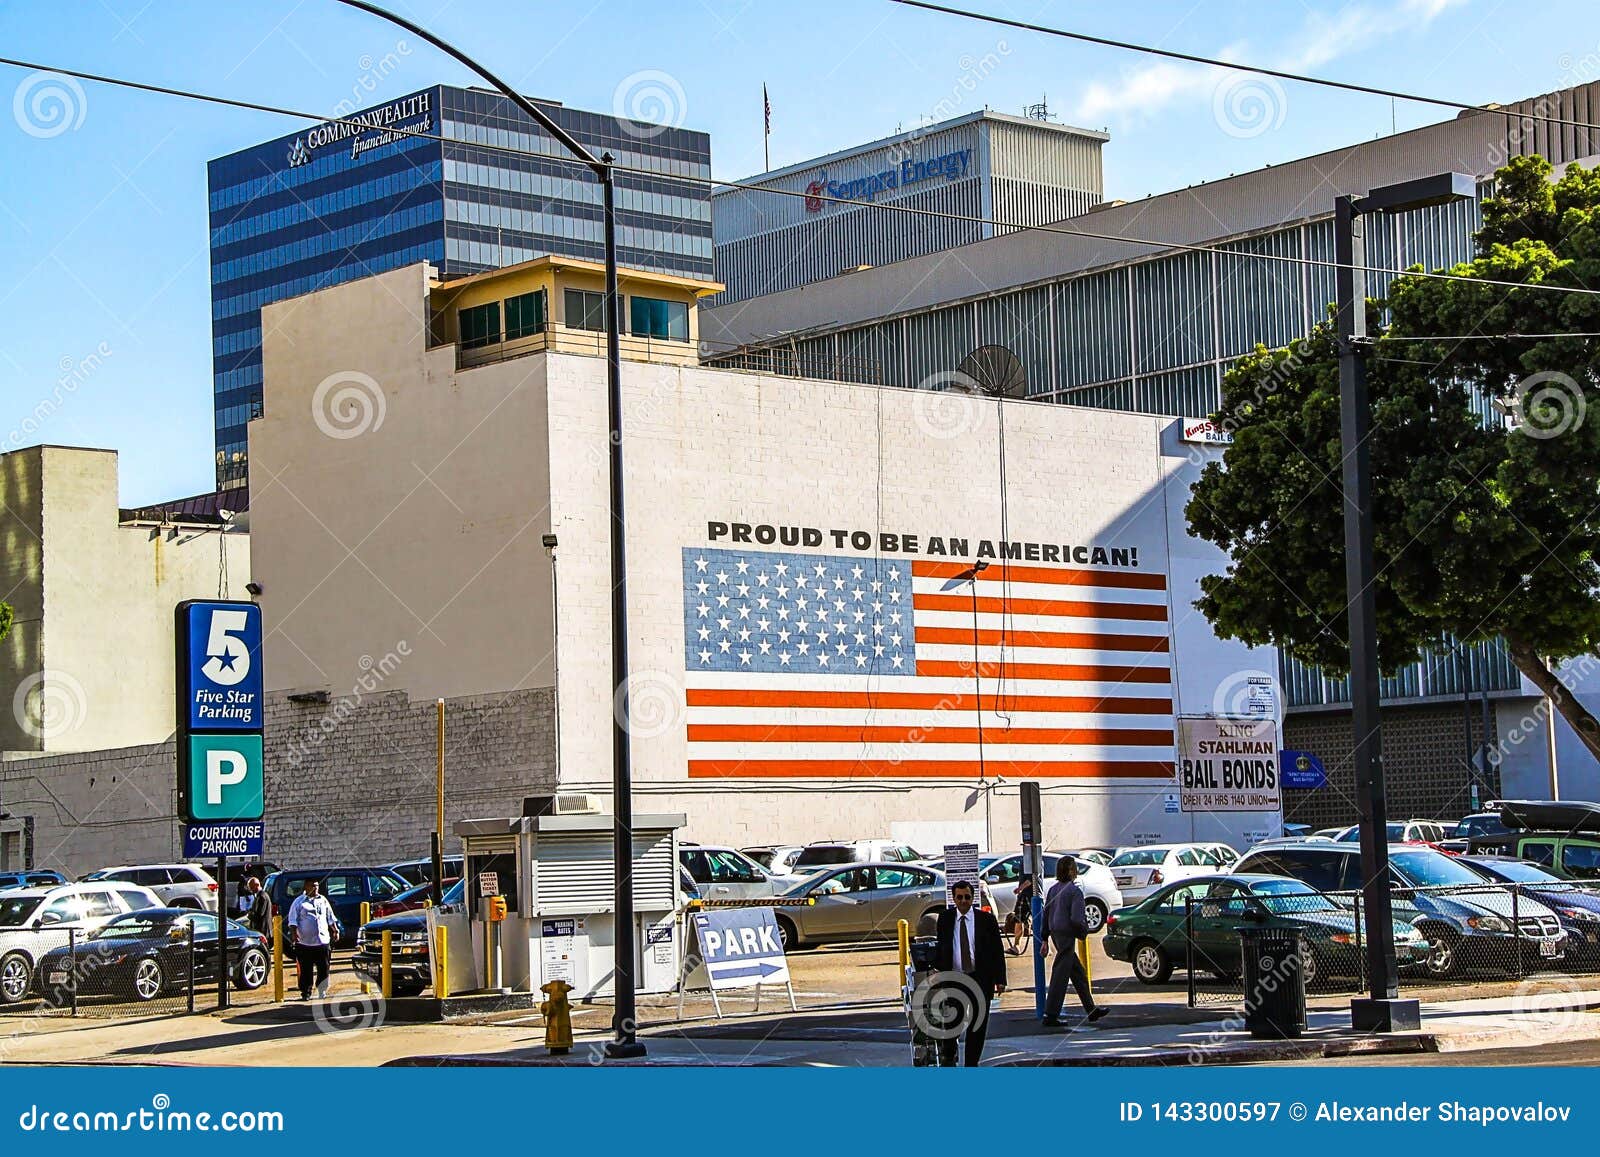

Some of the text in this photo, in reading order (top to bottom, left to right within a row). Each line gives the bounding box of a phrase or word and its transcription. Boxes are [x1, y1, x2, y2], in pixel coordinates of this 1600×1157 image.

[308, 92, 430, 149] COMMONWEALTH
[350, 125, 392, 160] financial
[827, 148, 971, 206] Sempra Energy
[707, 521, 1140, 568] PROUD TO BE AN AMERICAN!
[201, 609, 251, 686] 5
[195, 689, 255, 704] Five Star
[198, 704, 252, 723] Parking
[1198, 741, 1273, 754] STAHLMAN
[206, 749, 248, 805] P
[1183, 759, 1276, 789] BAIL BONDS
[1182, 795, 1268, 806] OPEN 24 HRS 1140 UNION
[189, 825, 261, 840] COURTHOUSE
[201, 840, 248, 854] PARKING
[703, 925, 780, 957] PARK
